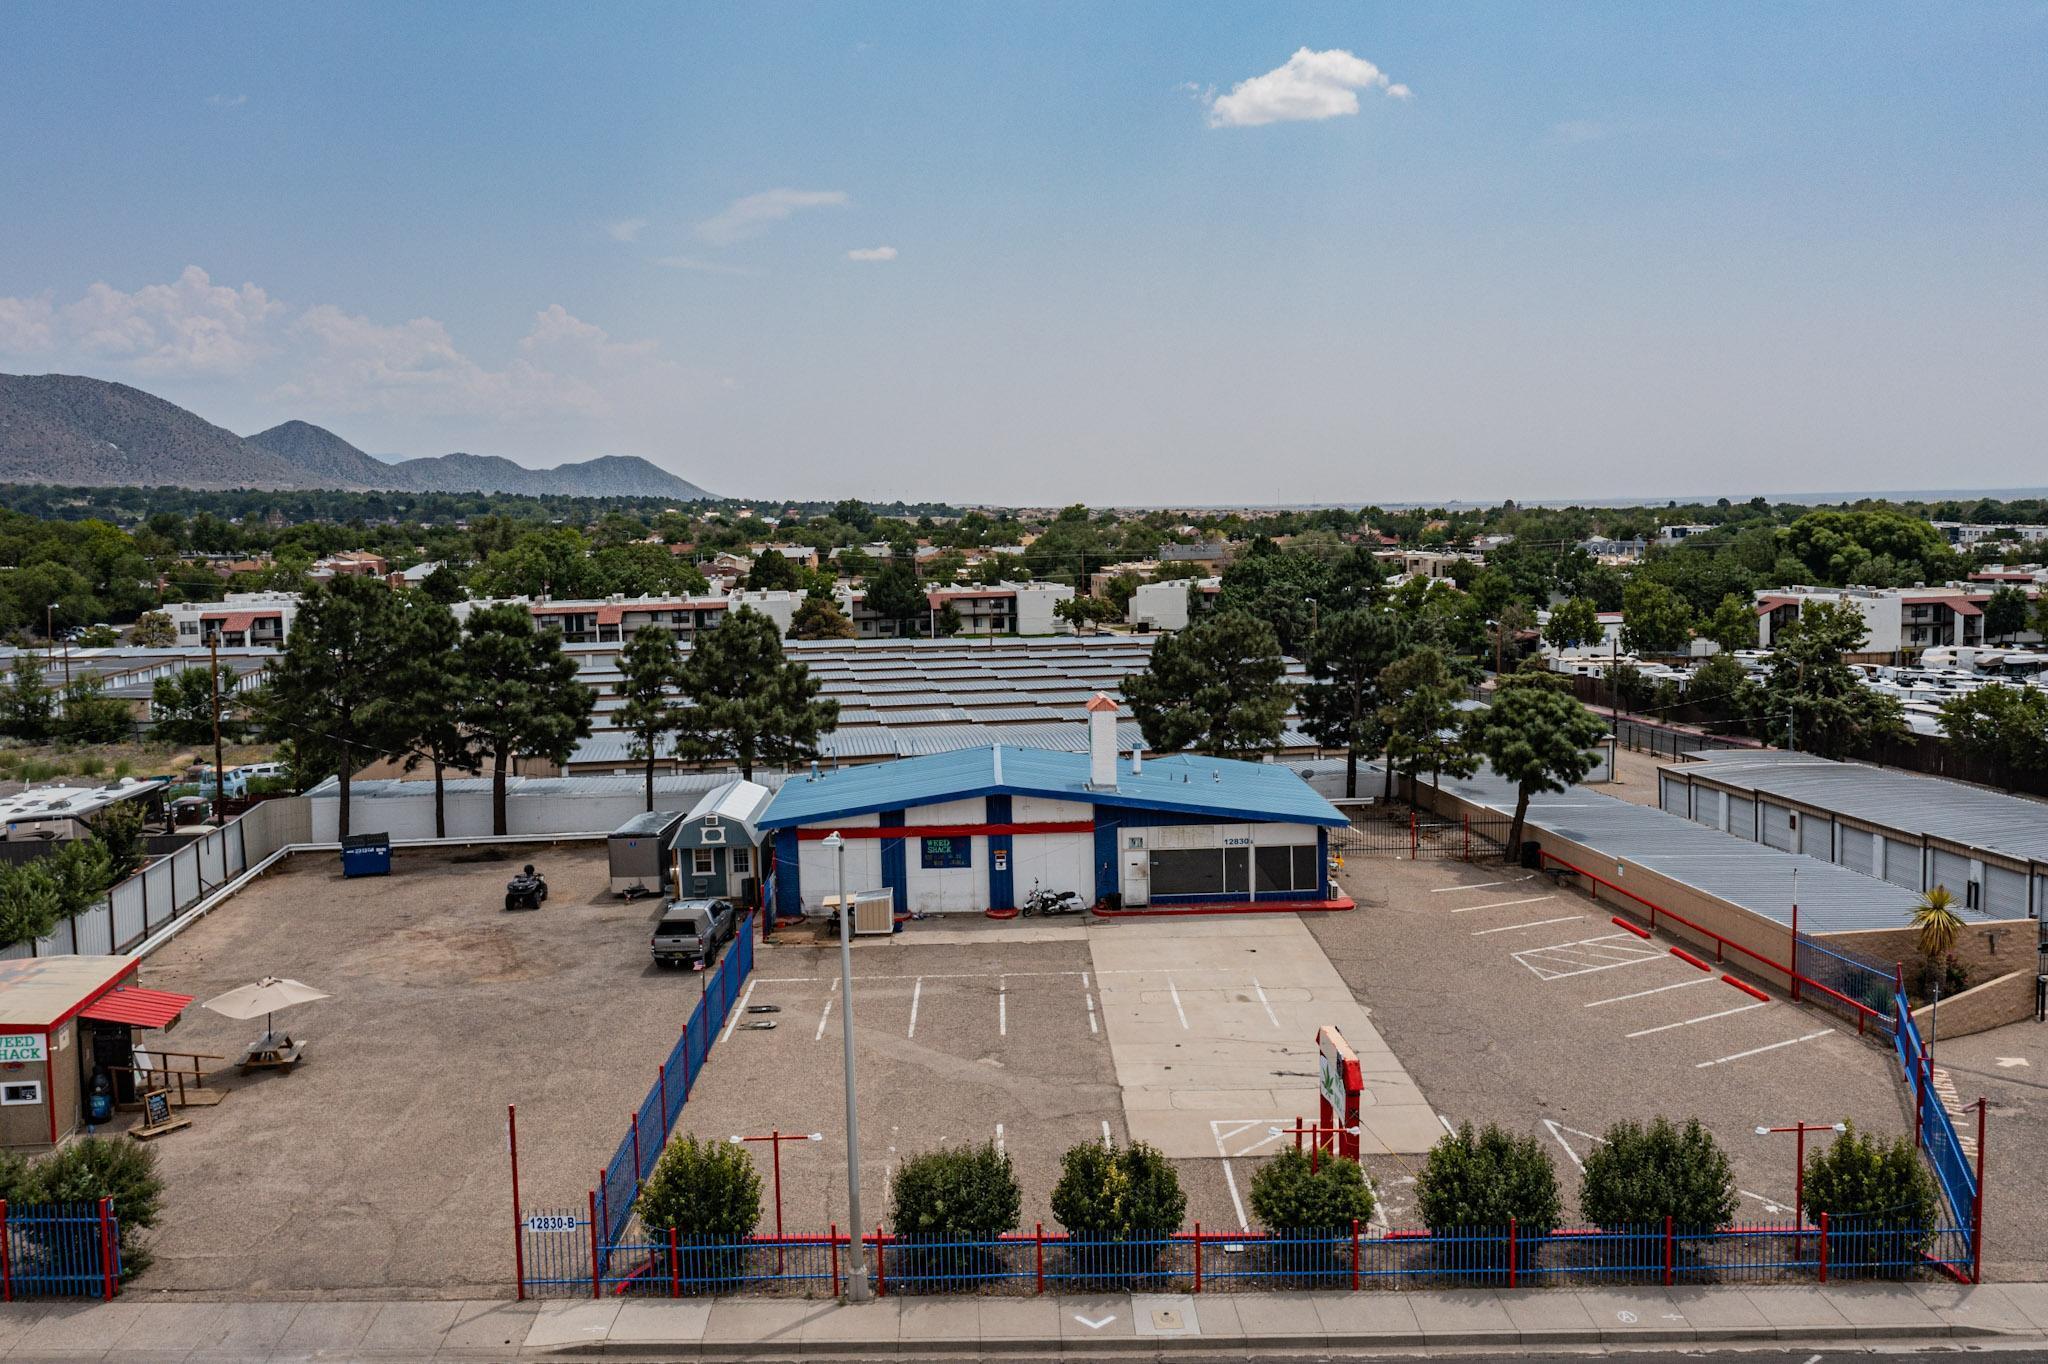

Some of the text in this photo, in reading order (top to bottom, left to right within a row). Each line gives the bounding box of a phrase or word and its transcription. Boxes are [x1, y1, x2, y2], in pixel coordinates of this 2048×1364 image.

[927, 839, 950, 847] WEED
[0, 1036, 35, 1047] EED
[0, 1048, 41, 1060] HACK
[530, 1217, 575, 1229] 12830-B
